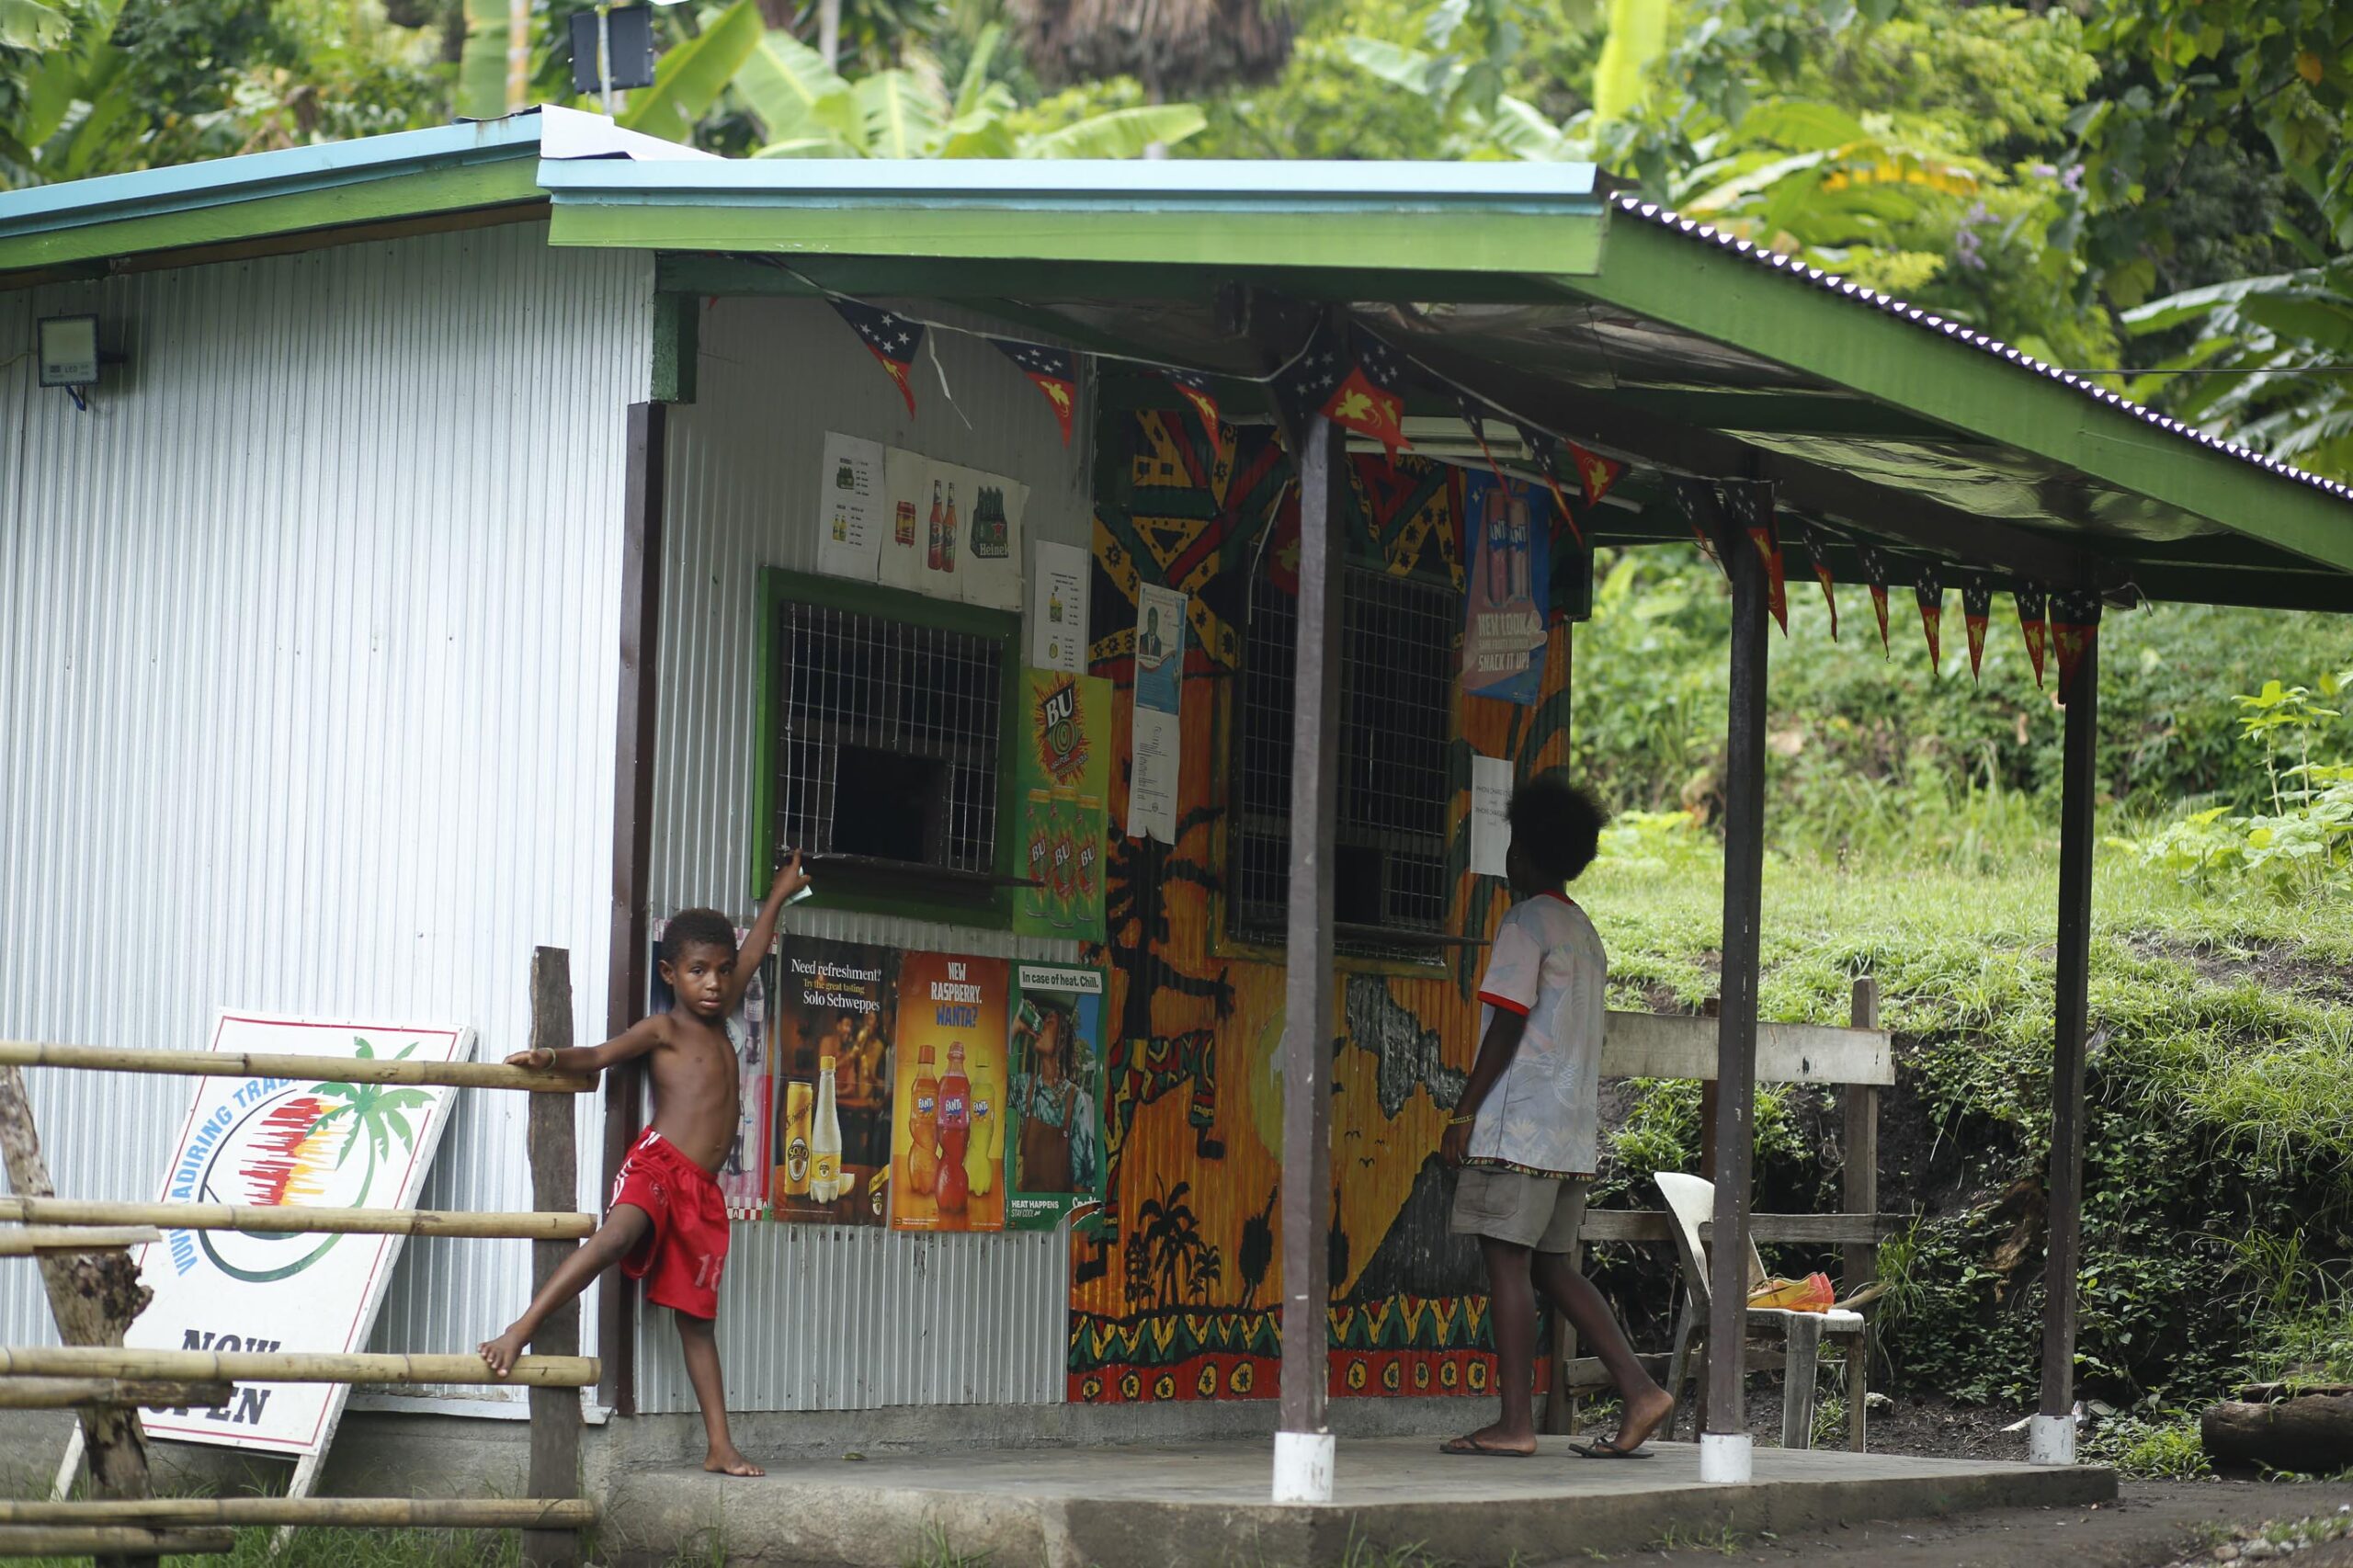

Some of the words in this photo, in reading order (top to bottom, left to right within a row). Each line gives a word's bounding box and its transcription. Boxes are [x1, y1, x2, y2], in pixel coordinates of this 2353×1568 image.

[1478, 653, 1505, 672] SNACK
[1506, 653, 1514, 670] IT
[1516, 652, 1529, 669] UP!
[791, 959, 816, 975] Need
[818, 961, 881, 982] refreshment?
[948, 961, 966, 981] NEW
[1022, 971, 1030, 983] In
[1031, 974, 1050, 983] case
[1051, 974, 1059, 984] of
[1080, 976, 1099, 988] Chill.
[814, 980, 824, 989] the
[825, 983, 842, 993] great
[931, 982, 983, 1004] RASPBERRY.
[803, 991, 825, 1006] Solo
[826, 993, 881, 1014] Schweppes
[937, 1006, 978, 1028] WANTA?
[789, 1147, 808, 1160] SOLO
[1011, 1199, 1029, 1209] HEAT
[1029, 1200, 1059, 1209] HAPPENS
[1011, 1209, 1022, 1217] STAY
